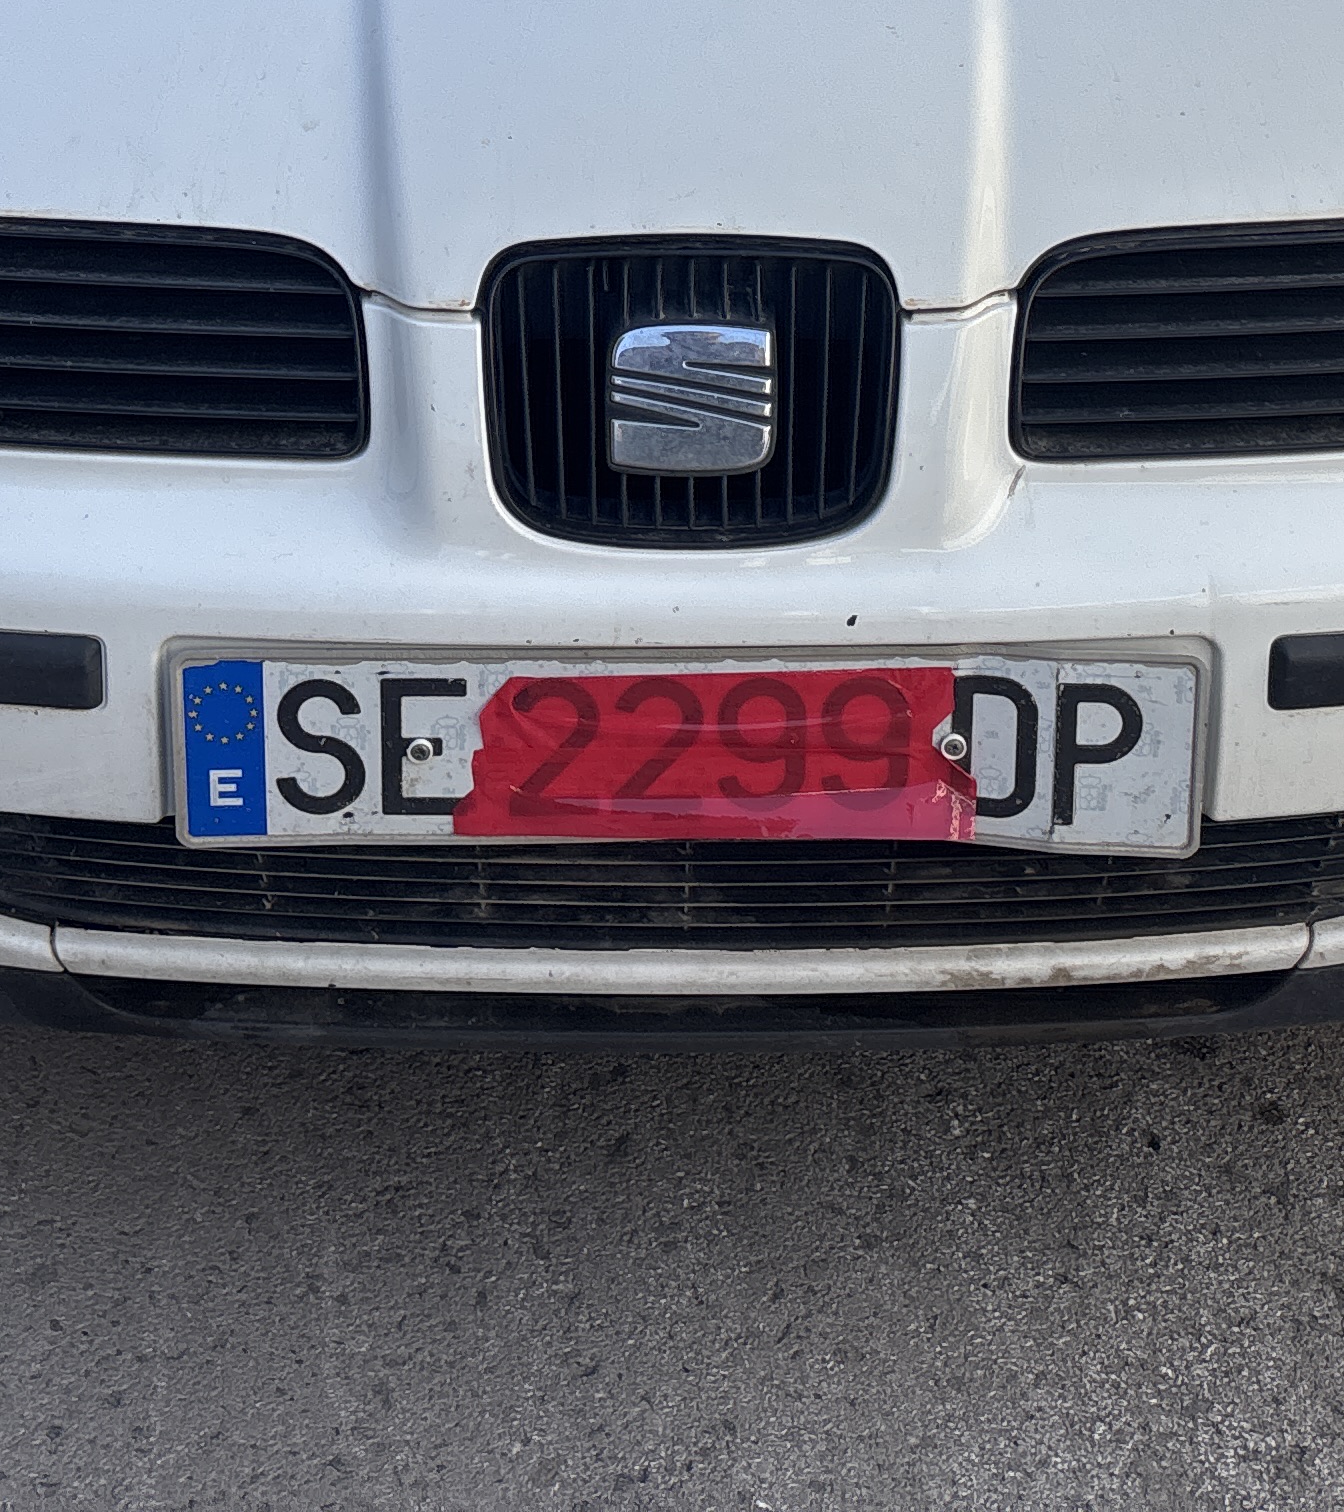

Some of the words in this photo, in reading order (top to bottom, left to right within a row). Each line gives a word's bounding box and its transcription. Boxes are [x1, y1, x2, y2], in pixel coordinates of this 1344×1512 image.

[208, 769, 244, 807] E
[275, 676, 469, 817] SE
[508, 675, 911, 817] 2299
[953, 675, 1142, 828] DP
